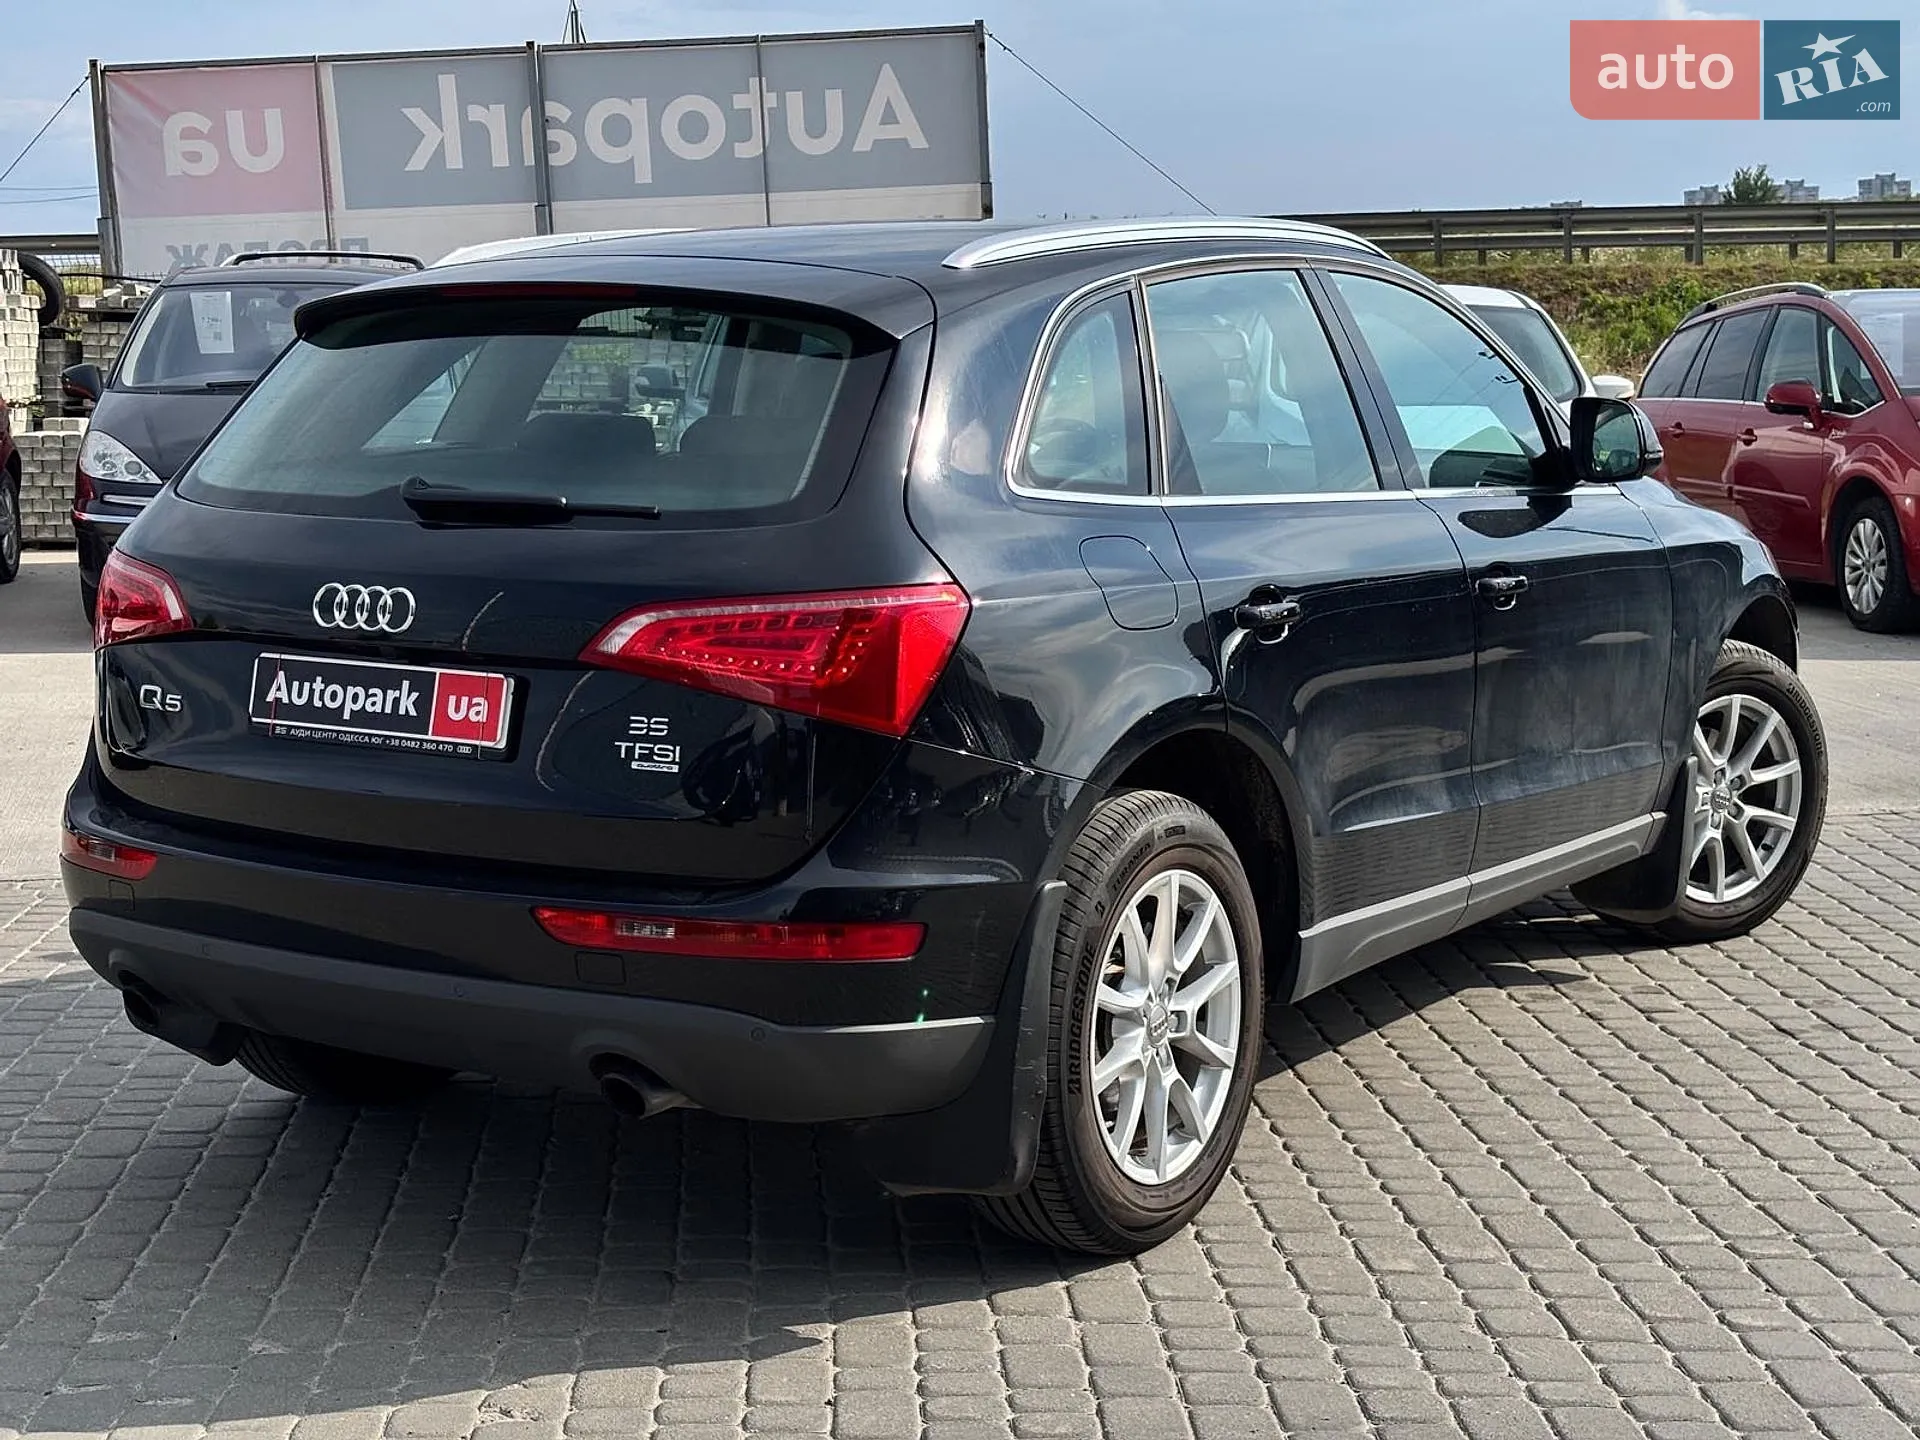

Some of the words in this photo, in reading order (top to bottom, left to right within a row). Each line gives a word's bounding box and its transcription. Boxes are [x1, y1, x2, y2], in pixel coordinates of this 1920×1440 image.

[140, 684, 182, 712] Q5
[265, 670, 420, 720] Autopark
[446, 693, 489, 723] ua
[289, 728, 311, 738] АУДИ
[311, 729, 337, 739] ЦЕНТР
[338, 733, 370, 743] ОДЕССА
[385, 738, 400, 747] +38
[400, 740, 421, 749] 0482
[437, 744, 454, 752] 470
[614, 741, 681, 762] TFSI
[1067, 943, 1096, 1096] BRIDGESTONE
